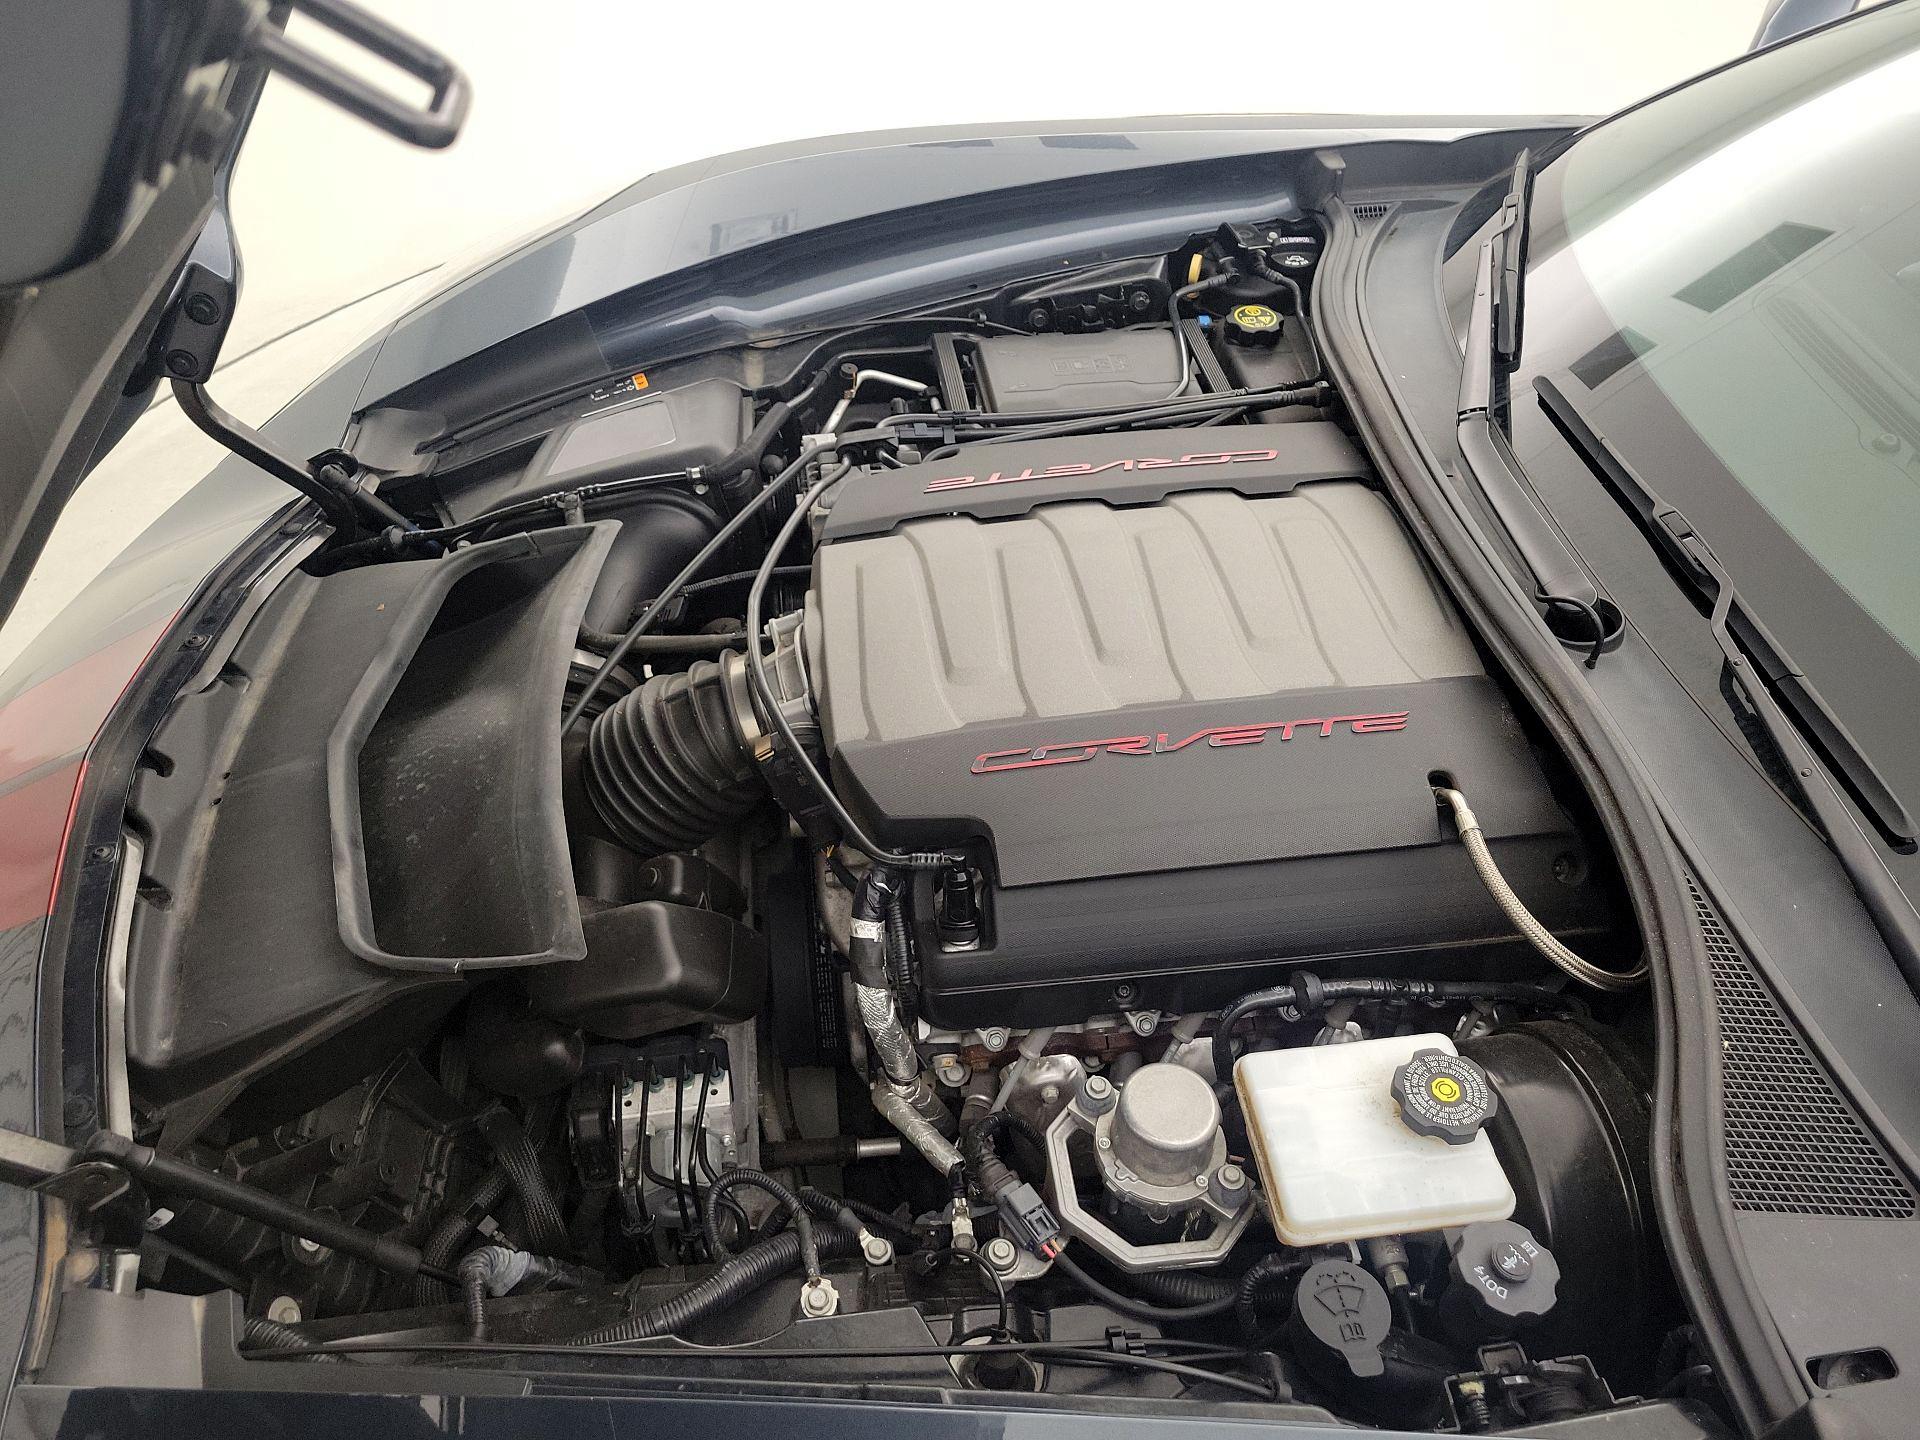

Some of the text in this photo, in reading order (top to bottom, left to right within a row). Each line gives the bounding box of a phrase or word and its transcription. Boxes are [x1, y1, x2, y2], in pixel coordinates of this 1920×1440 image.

[923, 449, 1279, 493] CORVETTE
[970, 710, 1410, 774] CORVETTE
[1473, 1265, 1508, 1299] DOT4
